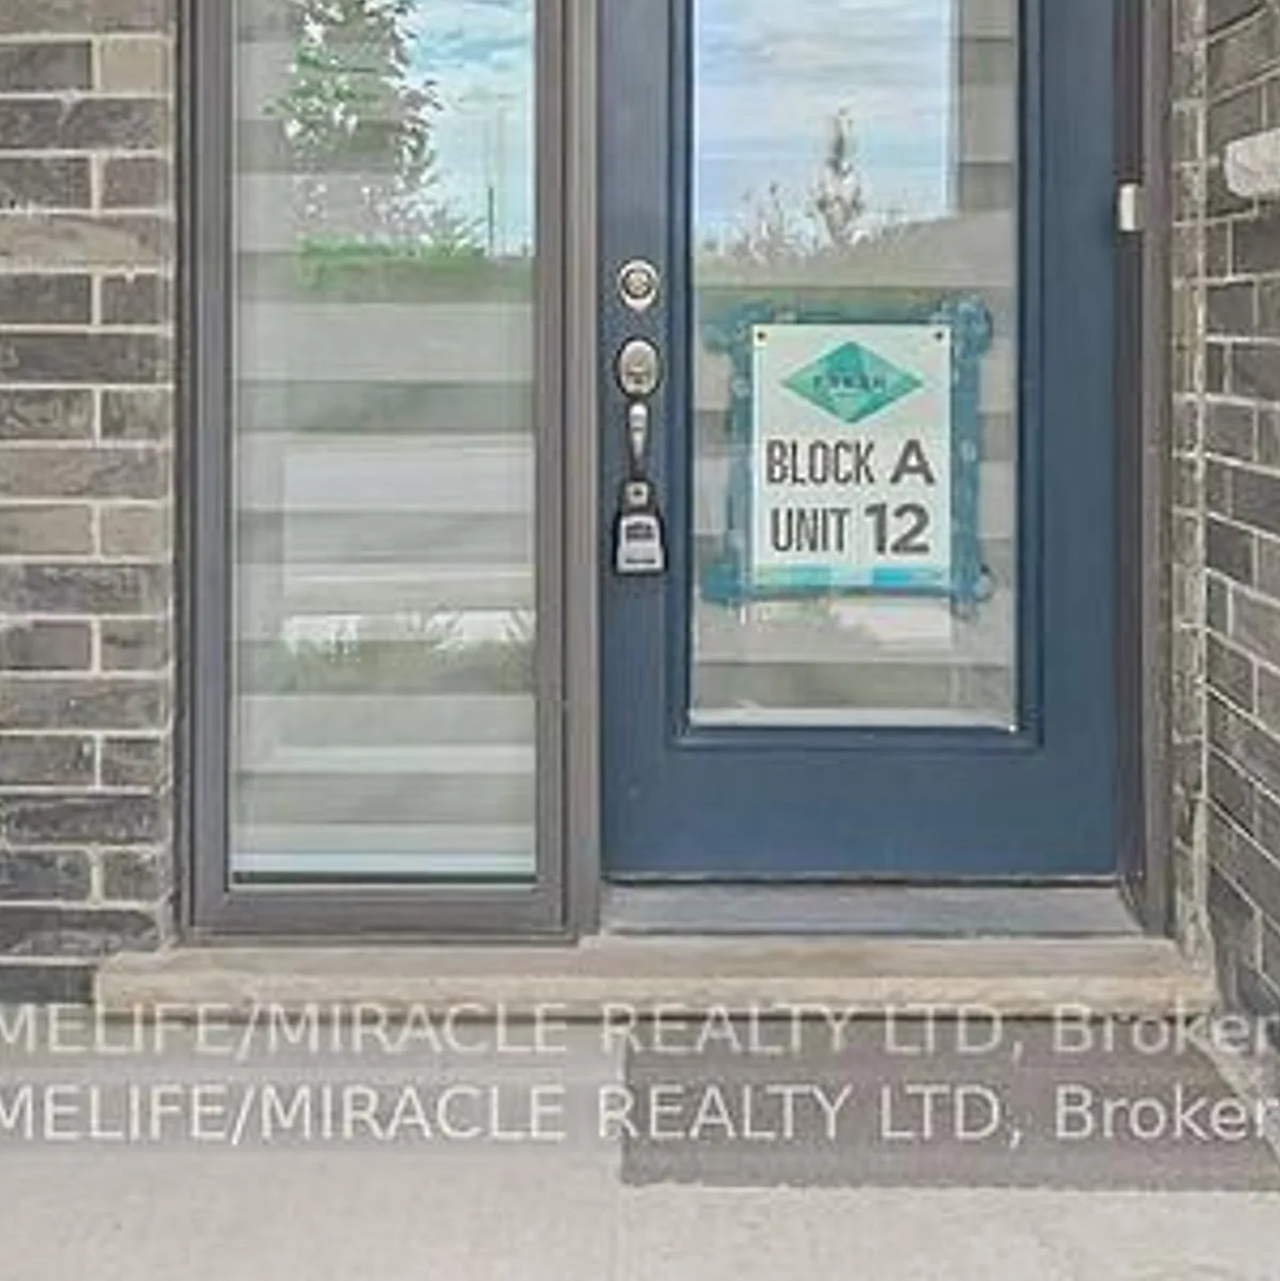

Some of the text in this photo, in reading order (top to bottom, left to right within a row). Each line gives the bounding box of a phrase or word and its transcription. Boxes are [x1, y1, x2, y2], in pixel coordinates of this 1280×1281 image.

[766, 438, 936, 486] BLOCK A
[770, 502, 930, 555] UNIT 12
